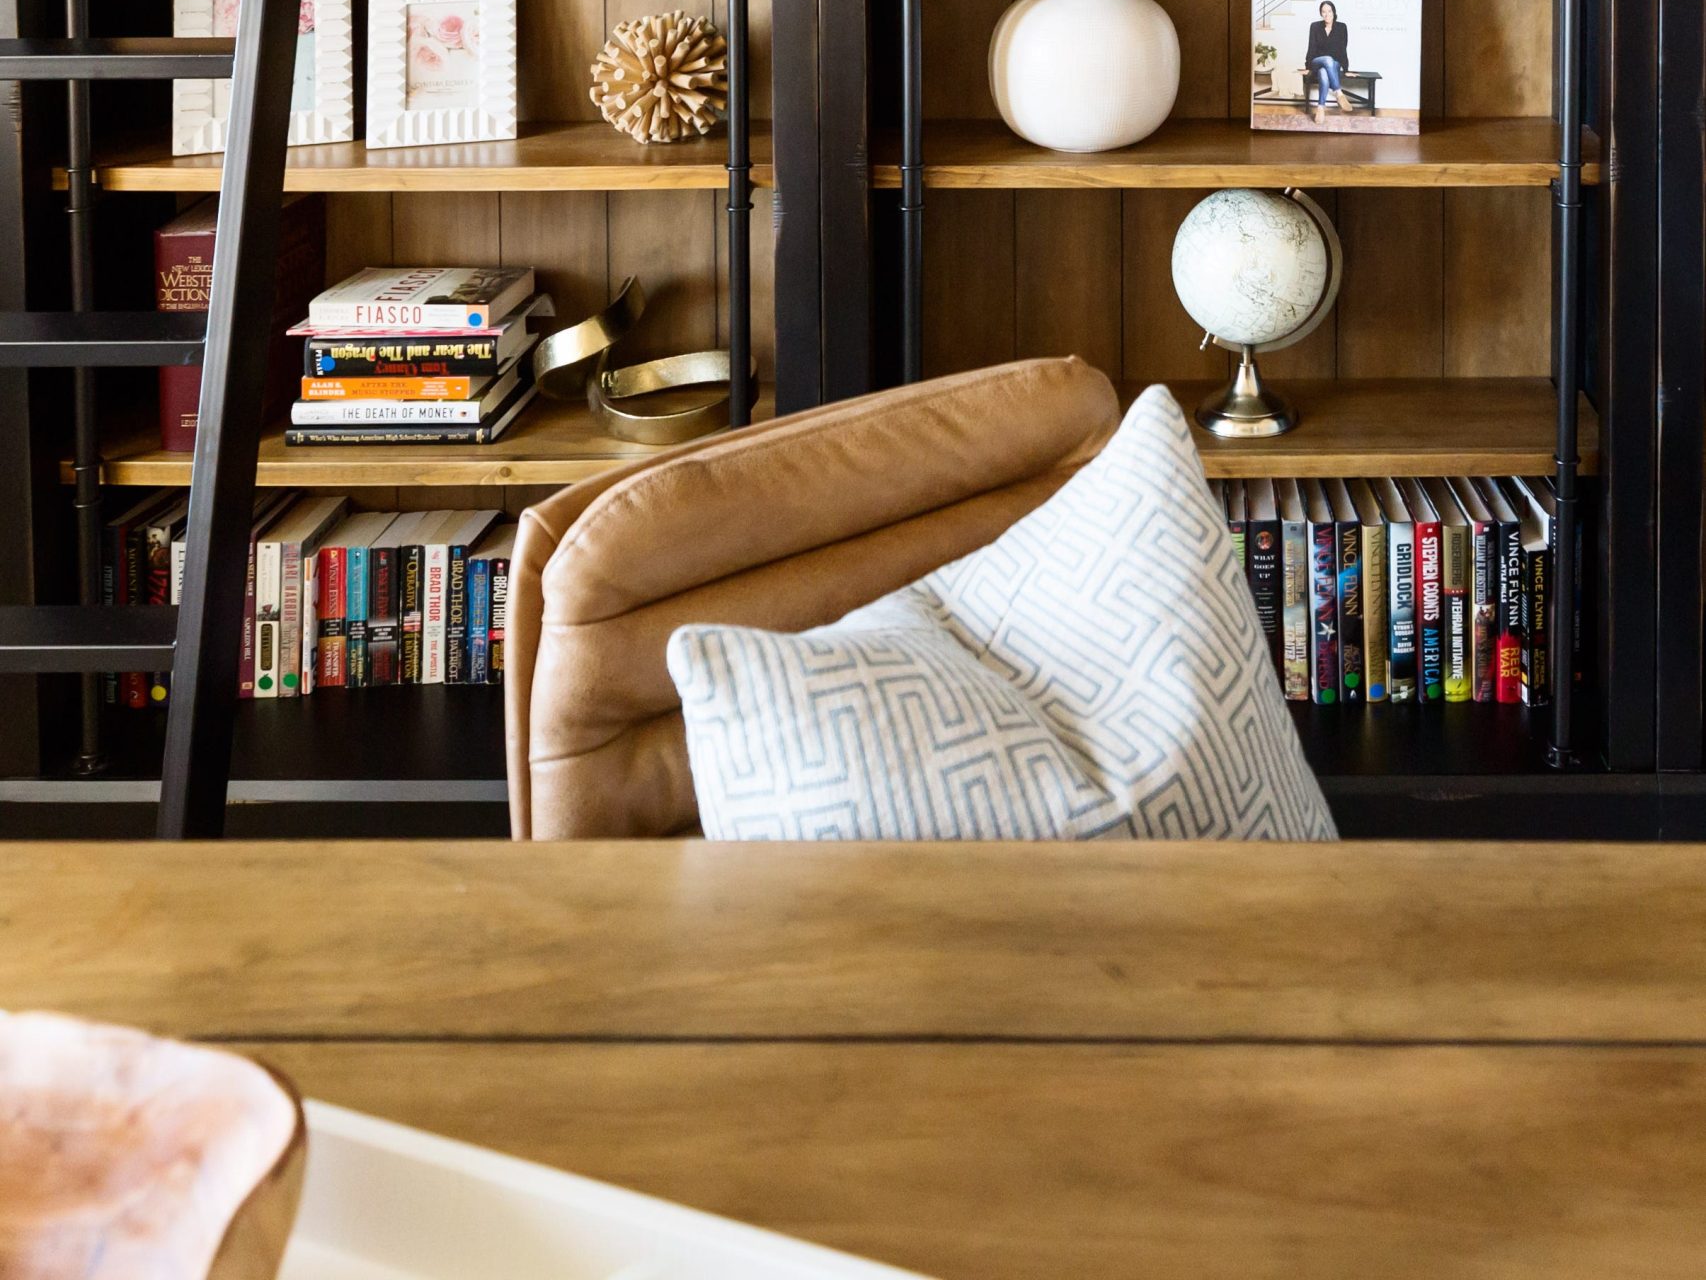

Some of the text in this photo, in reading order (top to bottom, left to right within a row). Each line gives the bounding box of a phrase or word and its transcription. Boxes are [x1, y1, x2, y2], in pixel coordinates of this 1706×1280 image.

[160, 272, 212, 287] WEBSTE
[160, 289, 209, 301] DICTION
[375, 268, 445, 301] FIASCO
[356, 306, 422, 324] FIASCO
[331, 342, 491, 361] The Bear and The Dragon
[374, 361, 450, 376] Tom Clancy
[342, 408, 360, 418] THE
[366, 408, 399, 418] DEATH
[402, 408, 414, 418] OF
[419, 407, 455, 418] MONEY
[285, 553, 298, 580] PEARL
[1343, 528, 1357, 615] VINCE FLYNN
[1451, 533, 1462, 585] ROSENBERG
[430, 567, 441, 592] BRAD
[451, 560, 463, 624] BRAD THOR
[1396, 543, 1412, 610] GRIDLOCK
[1508, 532, 1519, 626] VINCE FLYNN
[1535, 556, 1543, 630] VINCE FLYNN
[284, 586, 297, 622] HARBOR
[429, 595, 441, 621] THOR
[493, 576, 507, 628] BRAD THOR
[1422, 537, 1440, 685] STEPHEN COONTS AMERICA
[1296, 636, 1306, 664] BATTLE
[1452, 601, 1463, 679] TEHRAN INITIATIVE
[449, 640, 458, 679] PATRIOT
[1318, 641, 1328, 689] DEFEND
[1500, 647, 1510, 678] WAR
[1510, 647, 1519, 677] RED
